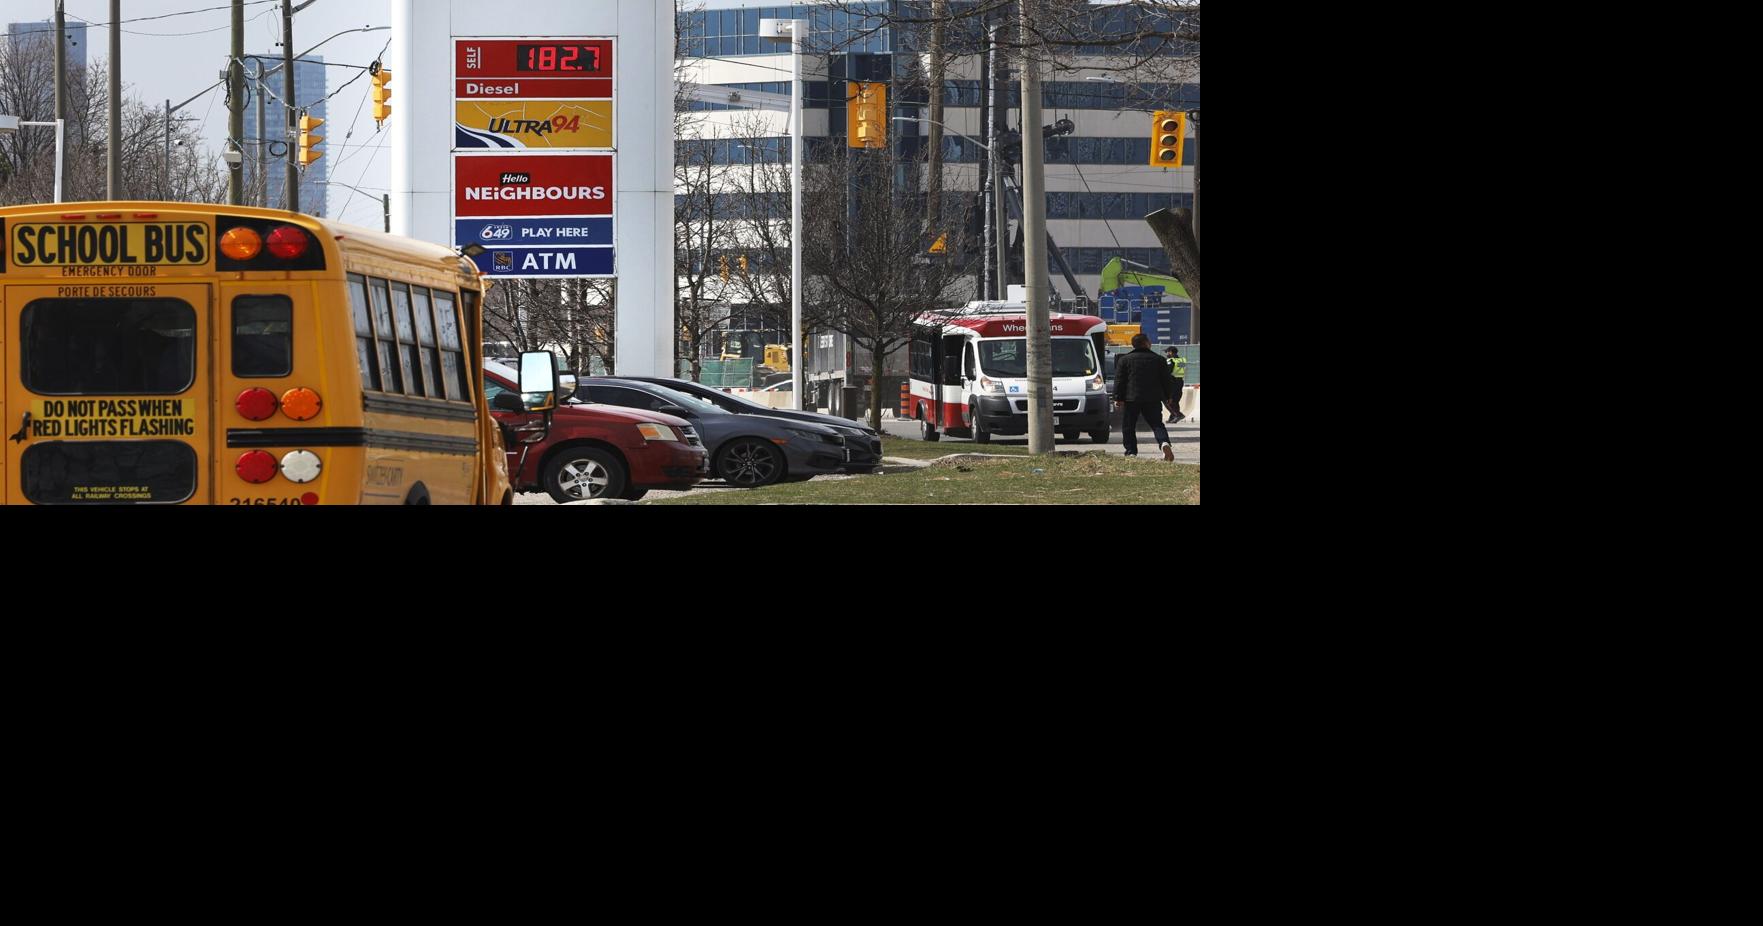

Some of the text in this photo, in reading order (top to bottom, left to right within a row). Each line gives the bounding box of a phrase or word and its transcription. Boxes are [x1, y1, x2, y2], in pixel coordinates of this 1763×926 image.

[466, 46, 477, 69] SELF
[528, 46, 600, 70] 182.7
[466, 83, 519, 95] Diesel
[502, 173, 529, 184] Hello
[521, 227, 589, 238] PLAY HERE
[17, 224, 205, 264] SCHOOL BUS
[522, 252, 576, 270] ATM
[62, 266, 157, 277] EMERGENCY DOOR
[58, 286, 156, 297] PORTE DE SECOURS
[43, 399, 182, 418] DO NOT PASS WHEN
[32, 418, 194, 437] RED LIGHTS FLASHING
